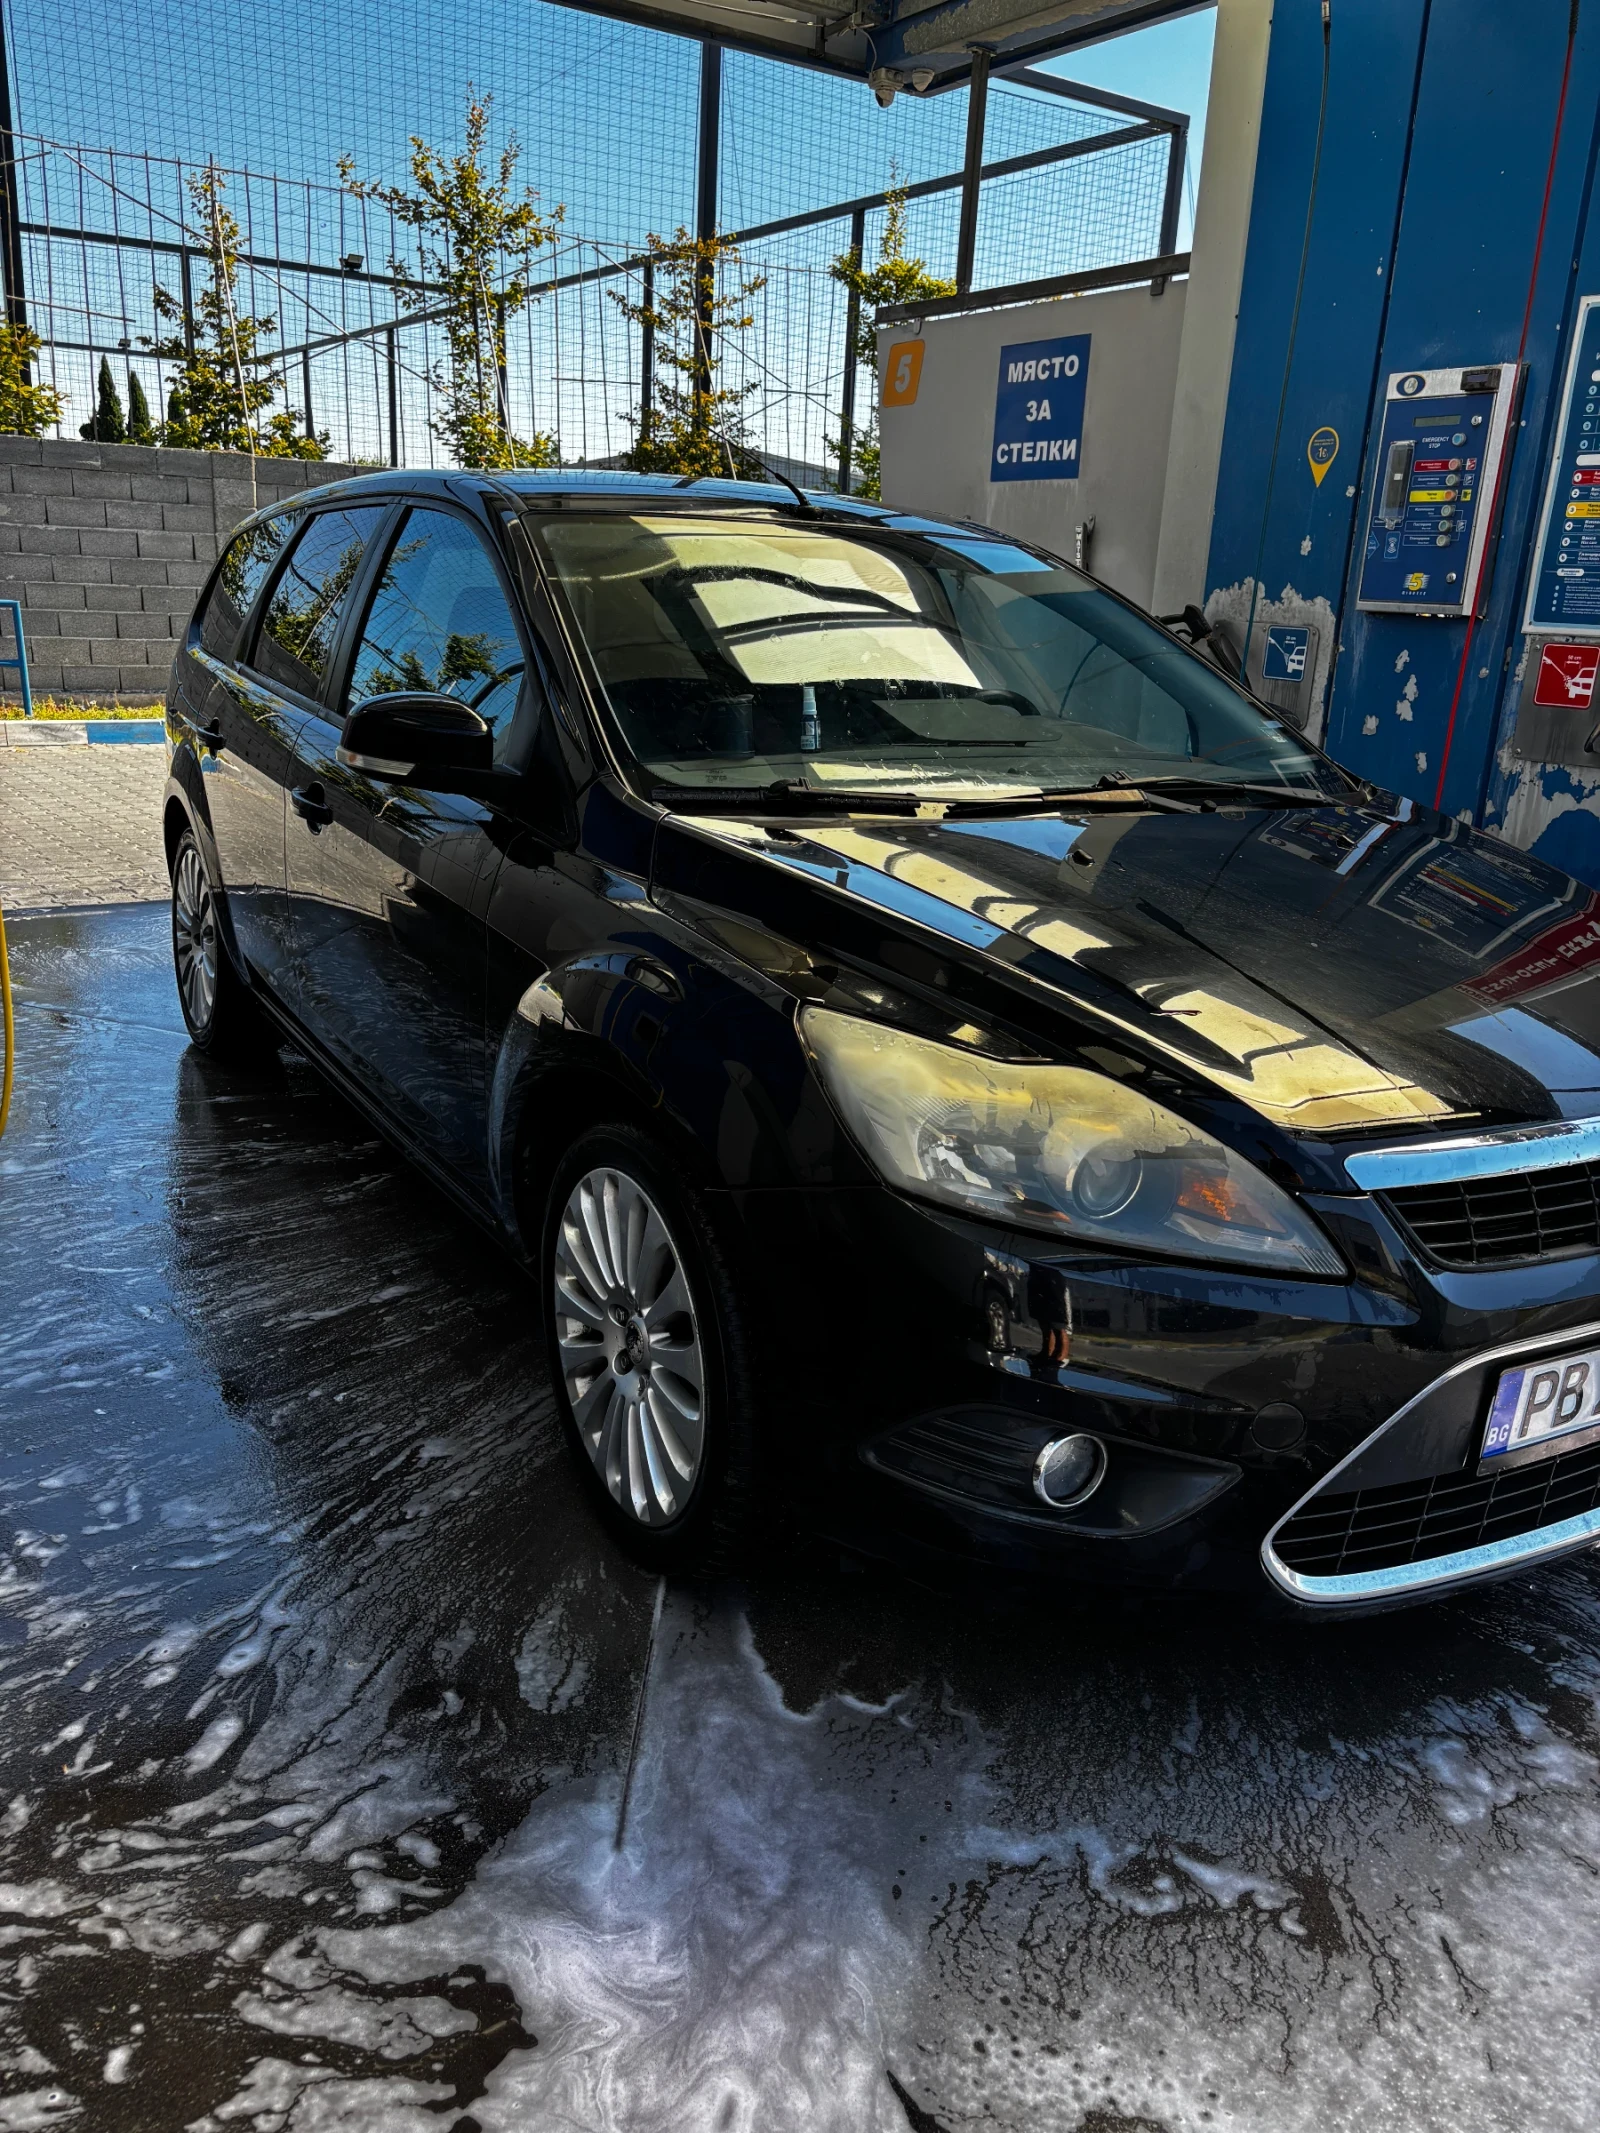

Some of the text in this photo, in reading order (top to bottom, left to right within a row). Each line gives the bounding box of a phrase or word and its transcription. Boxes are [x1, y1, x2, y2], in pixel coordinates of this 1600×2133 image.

[894, 353, 913, 394] 5
[1007, 354, 1079, 383] МЯСТО
[1025, 399, 1052, 421] ЗА
[996, 439, 1077, 464] СТЕЛКИ
[1408, 572, 1425, 591] 5
[1517, 1361, 1600, 1439] PB
[1486, 1423, 1510, 1446] BG
